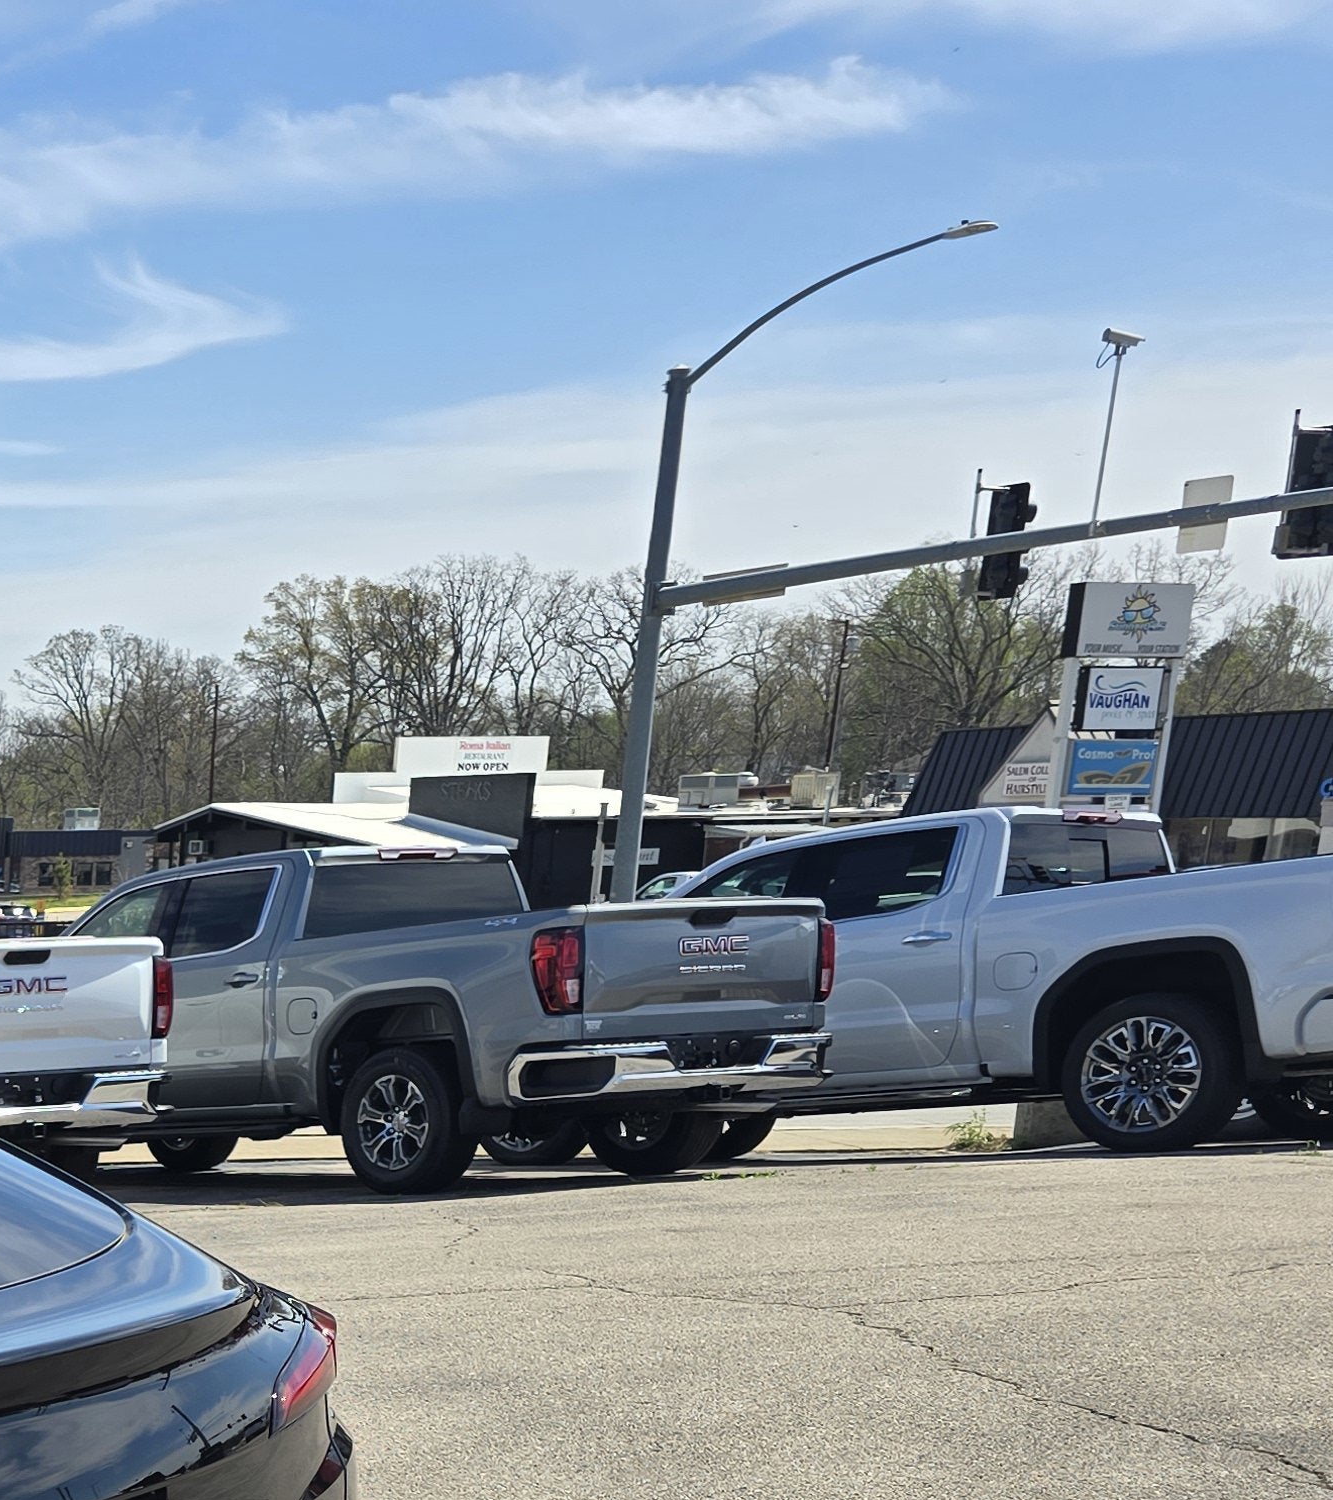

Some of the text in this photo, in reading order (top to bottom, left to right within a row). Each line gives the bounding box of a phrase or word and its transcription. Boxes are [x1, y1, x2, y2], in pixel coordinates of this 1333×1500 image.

[1089, 693, 1150, 709] VAUGHAN
[459, 741, 484, 750] Roma
[1078, 747, 1156, 760] Cosmo Prof
[457, 762, 509, 771] NOW OPEN
[1006, 765, 1029, 776] SALEM
[679, 934, 750, 957] GMC
